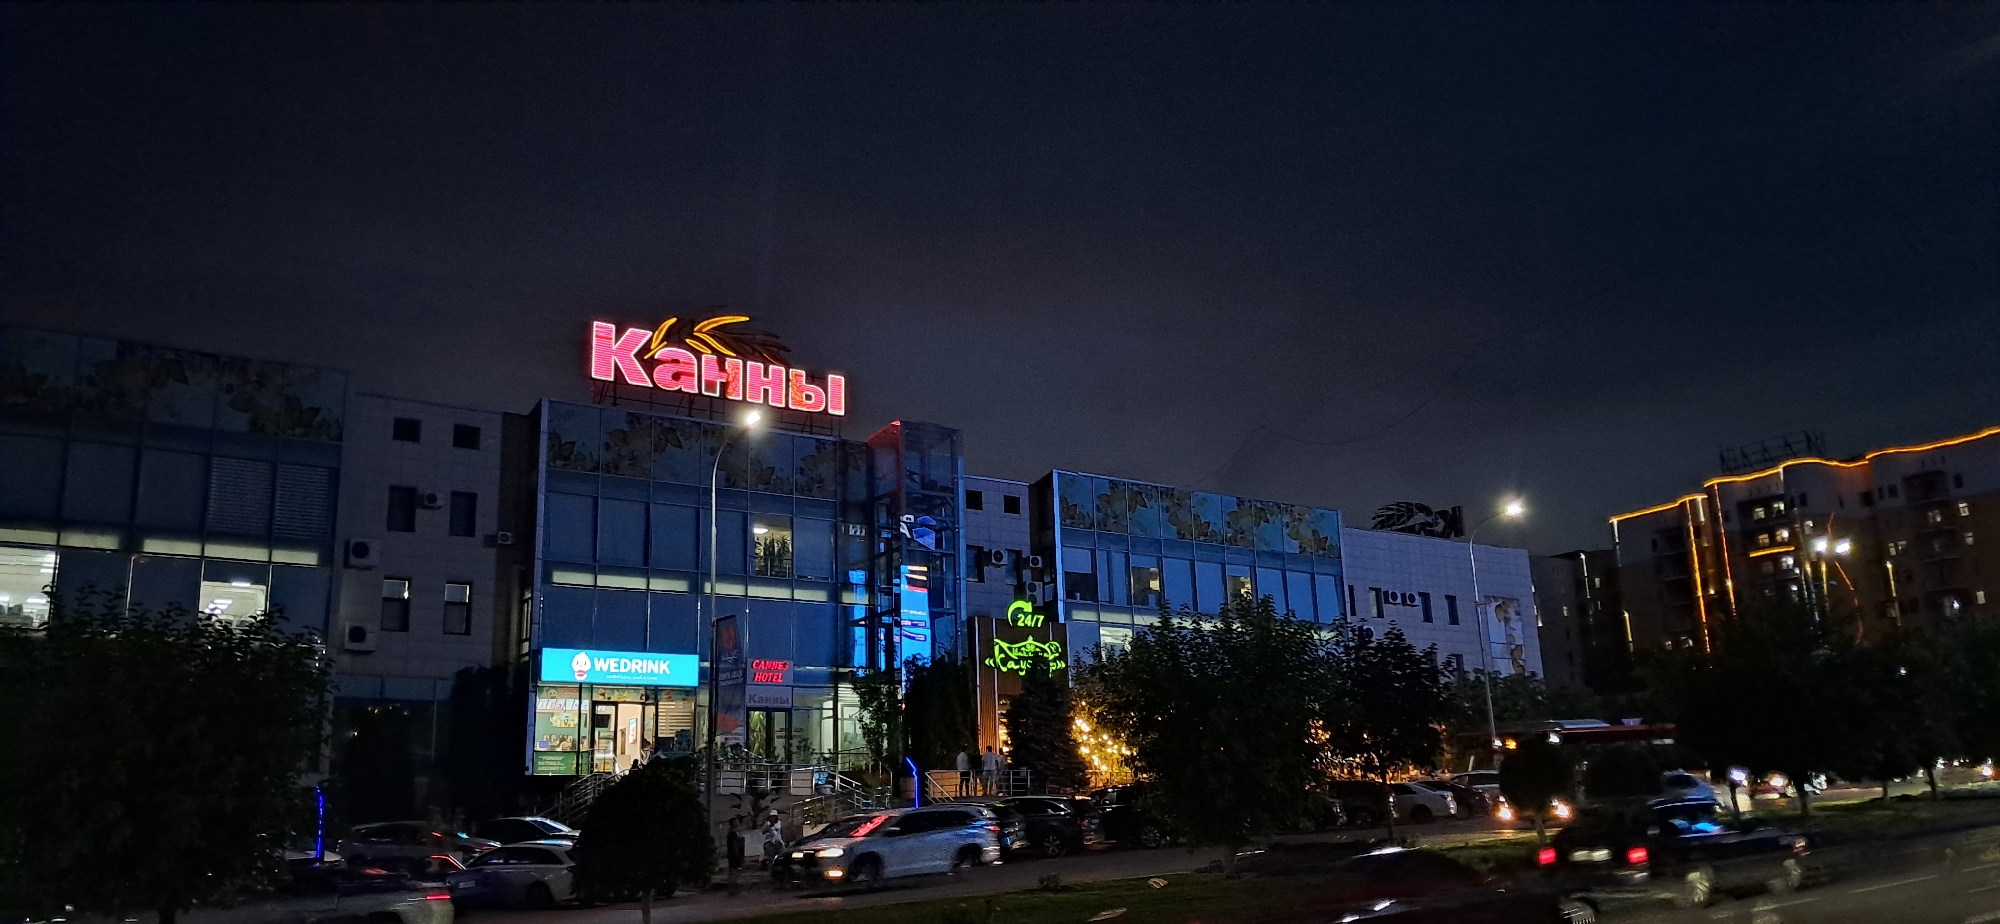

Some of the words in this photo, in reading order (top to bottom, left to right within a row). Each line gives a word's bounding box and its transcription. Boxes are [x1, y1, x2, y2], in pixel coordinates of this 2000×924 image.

[591, 321, 845, 416] Канны
[1017, 614, 1044, 628] 24/7
[593, 657, 671, 675] WEDRINK
[754, 672, 784, 683] HOTEL
[748, 693, 789, 705] Канны
